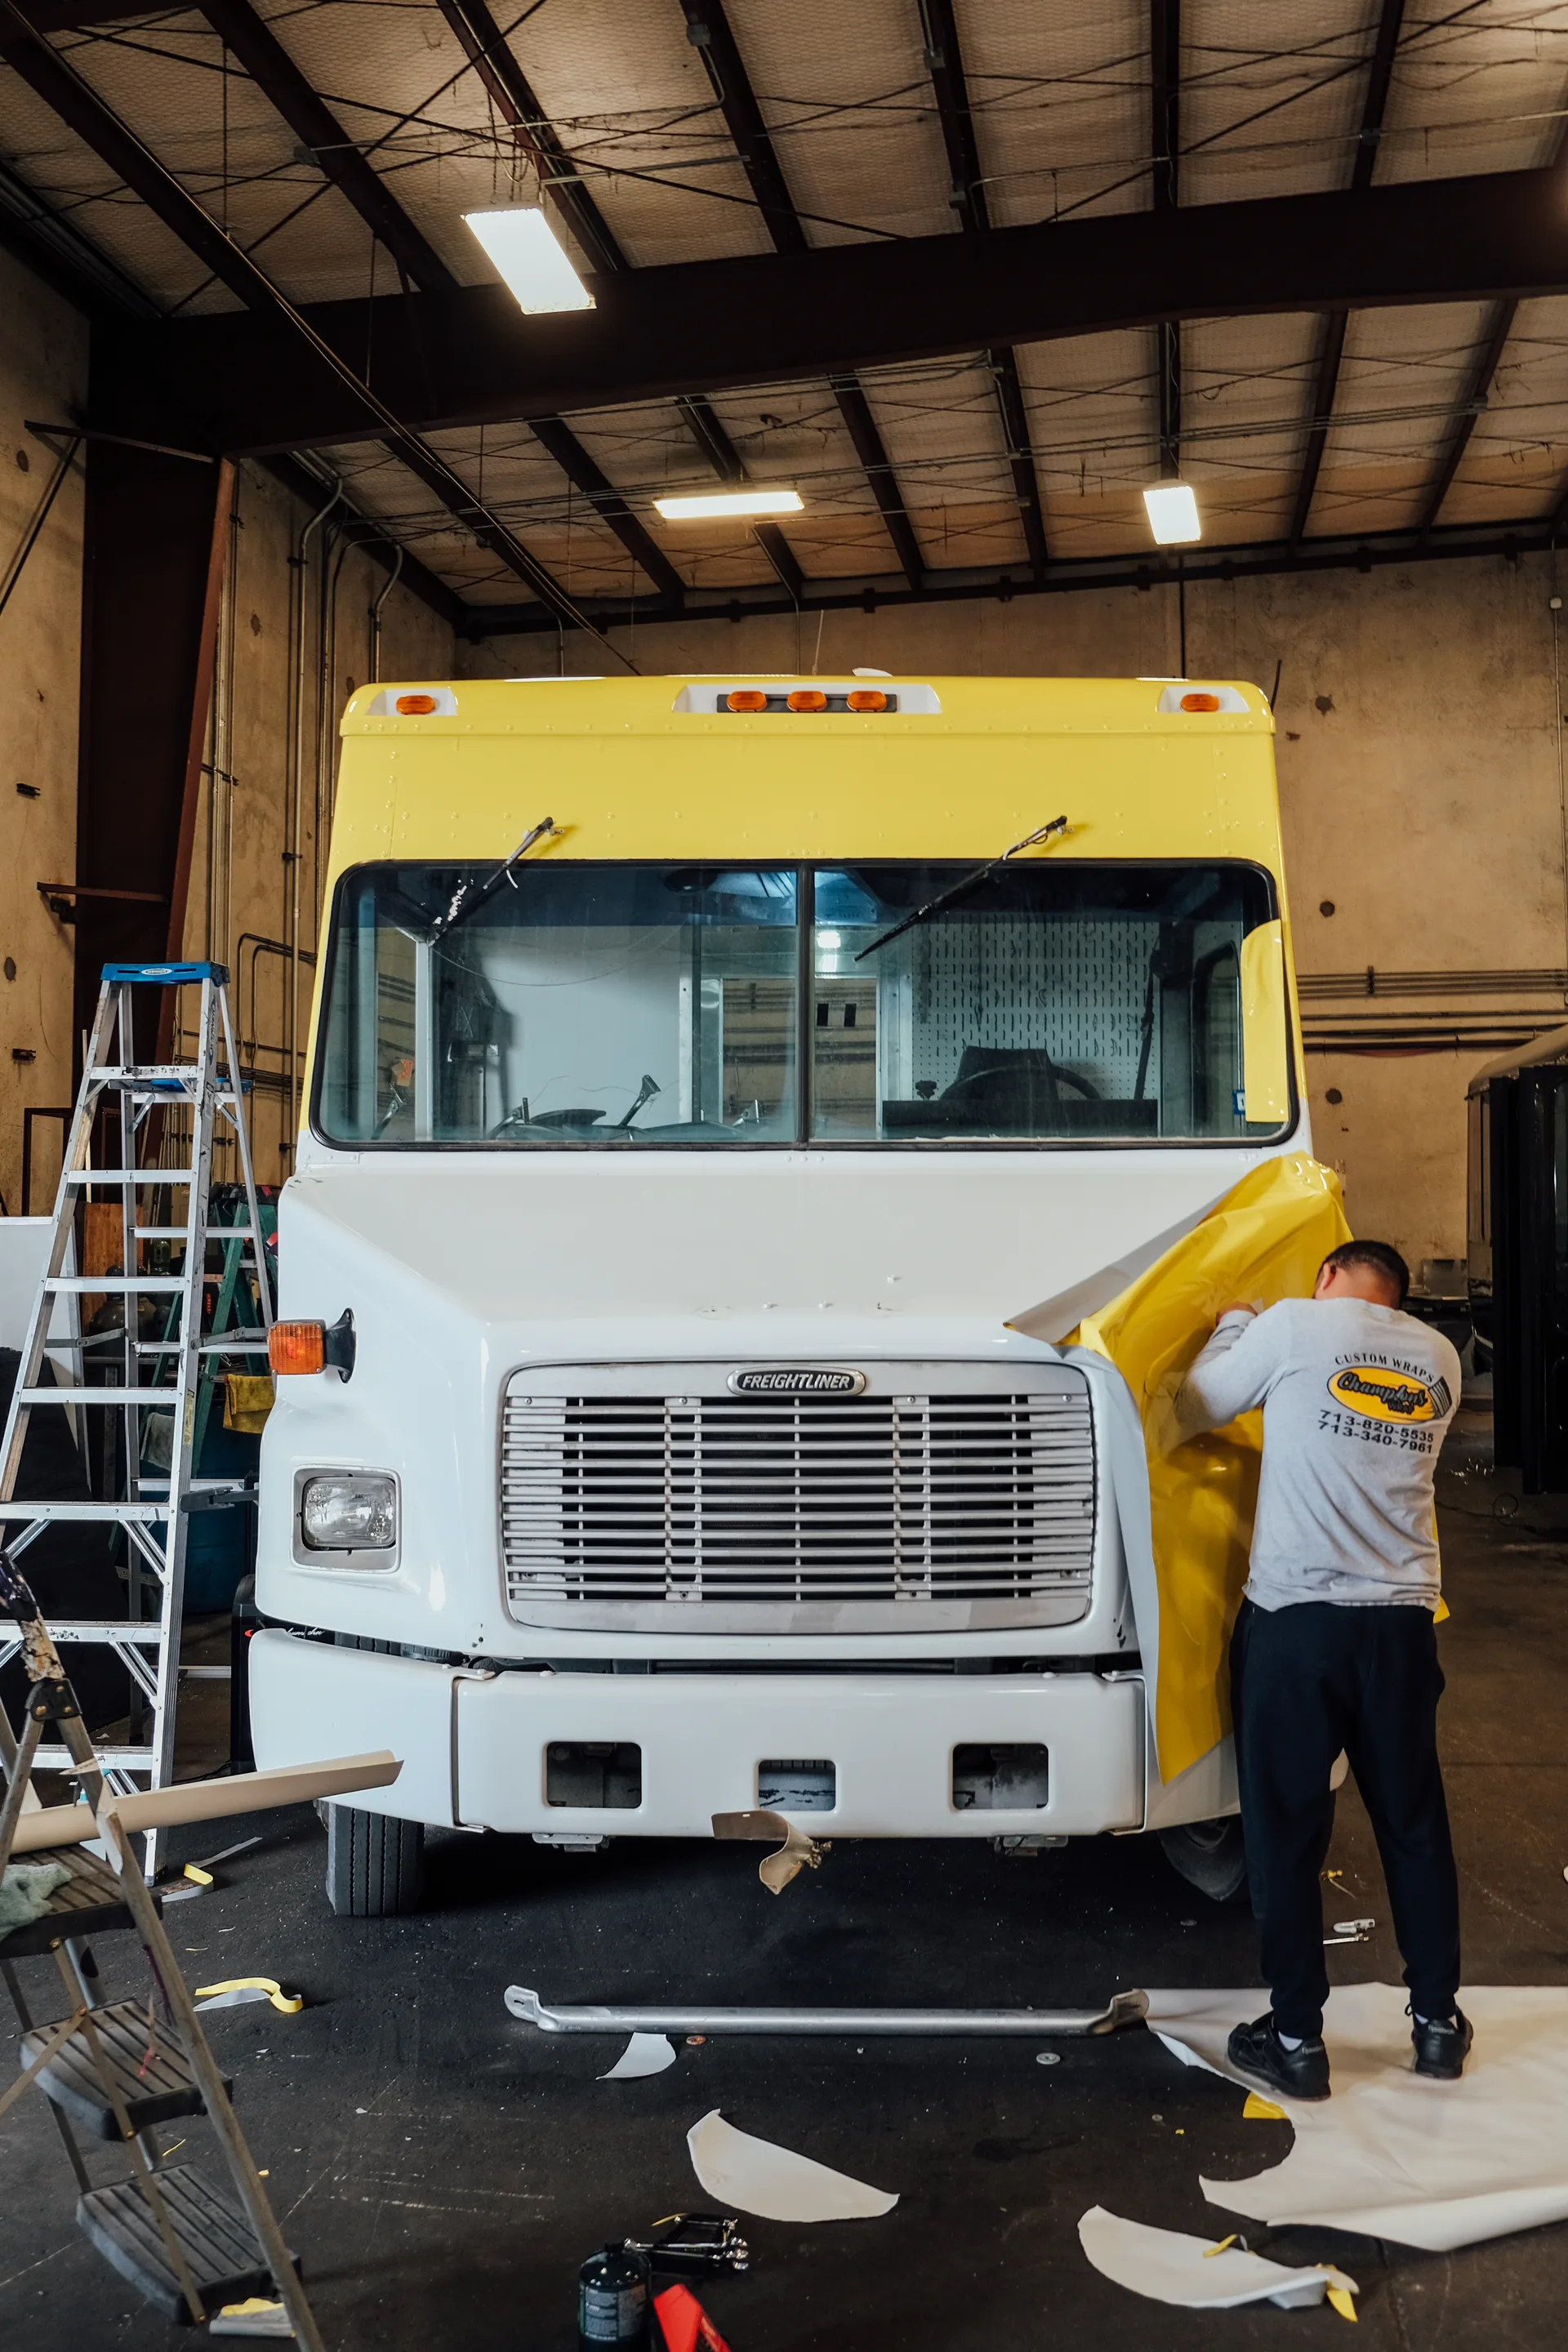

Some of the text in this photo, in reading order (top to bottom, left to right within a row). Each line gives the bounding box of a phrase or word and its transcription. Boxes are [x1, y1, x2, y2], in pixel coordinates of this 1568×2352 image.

[742, 1374, 850, 1389] FREIGHTLINER
[1334, 1352, 1435, 1383] CUSTOM WRAPS
[1317, 1420, 1432, 1454] 713-340-7961
[1320, 1410, 1434, 1443] 713-820-5535
